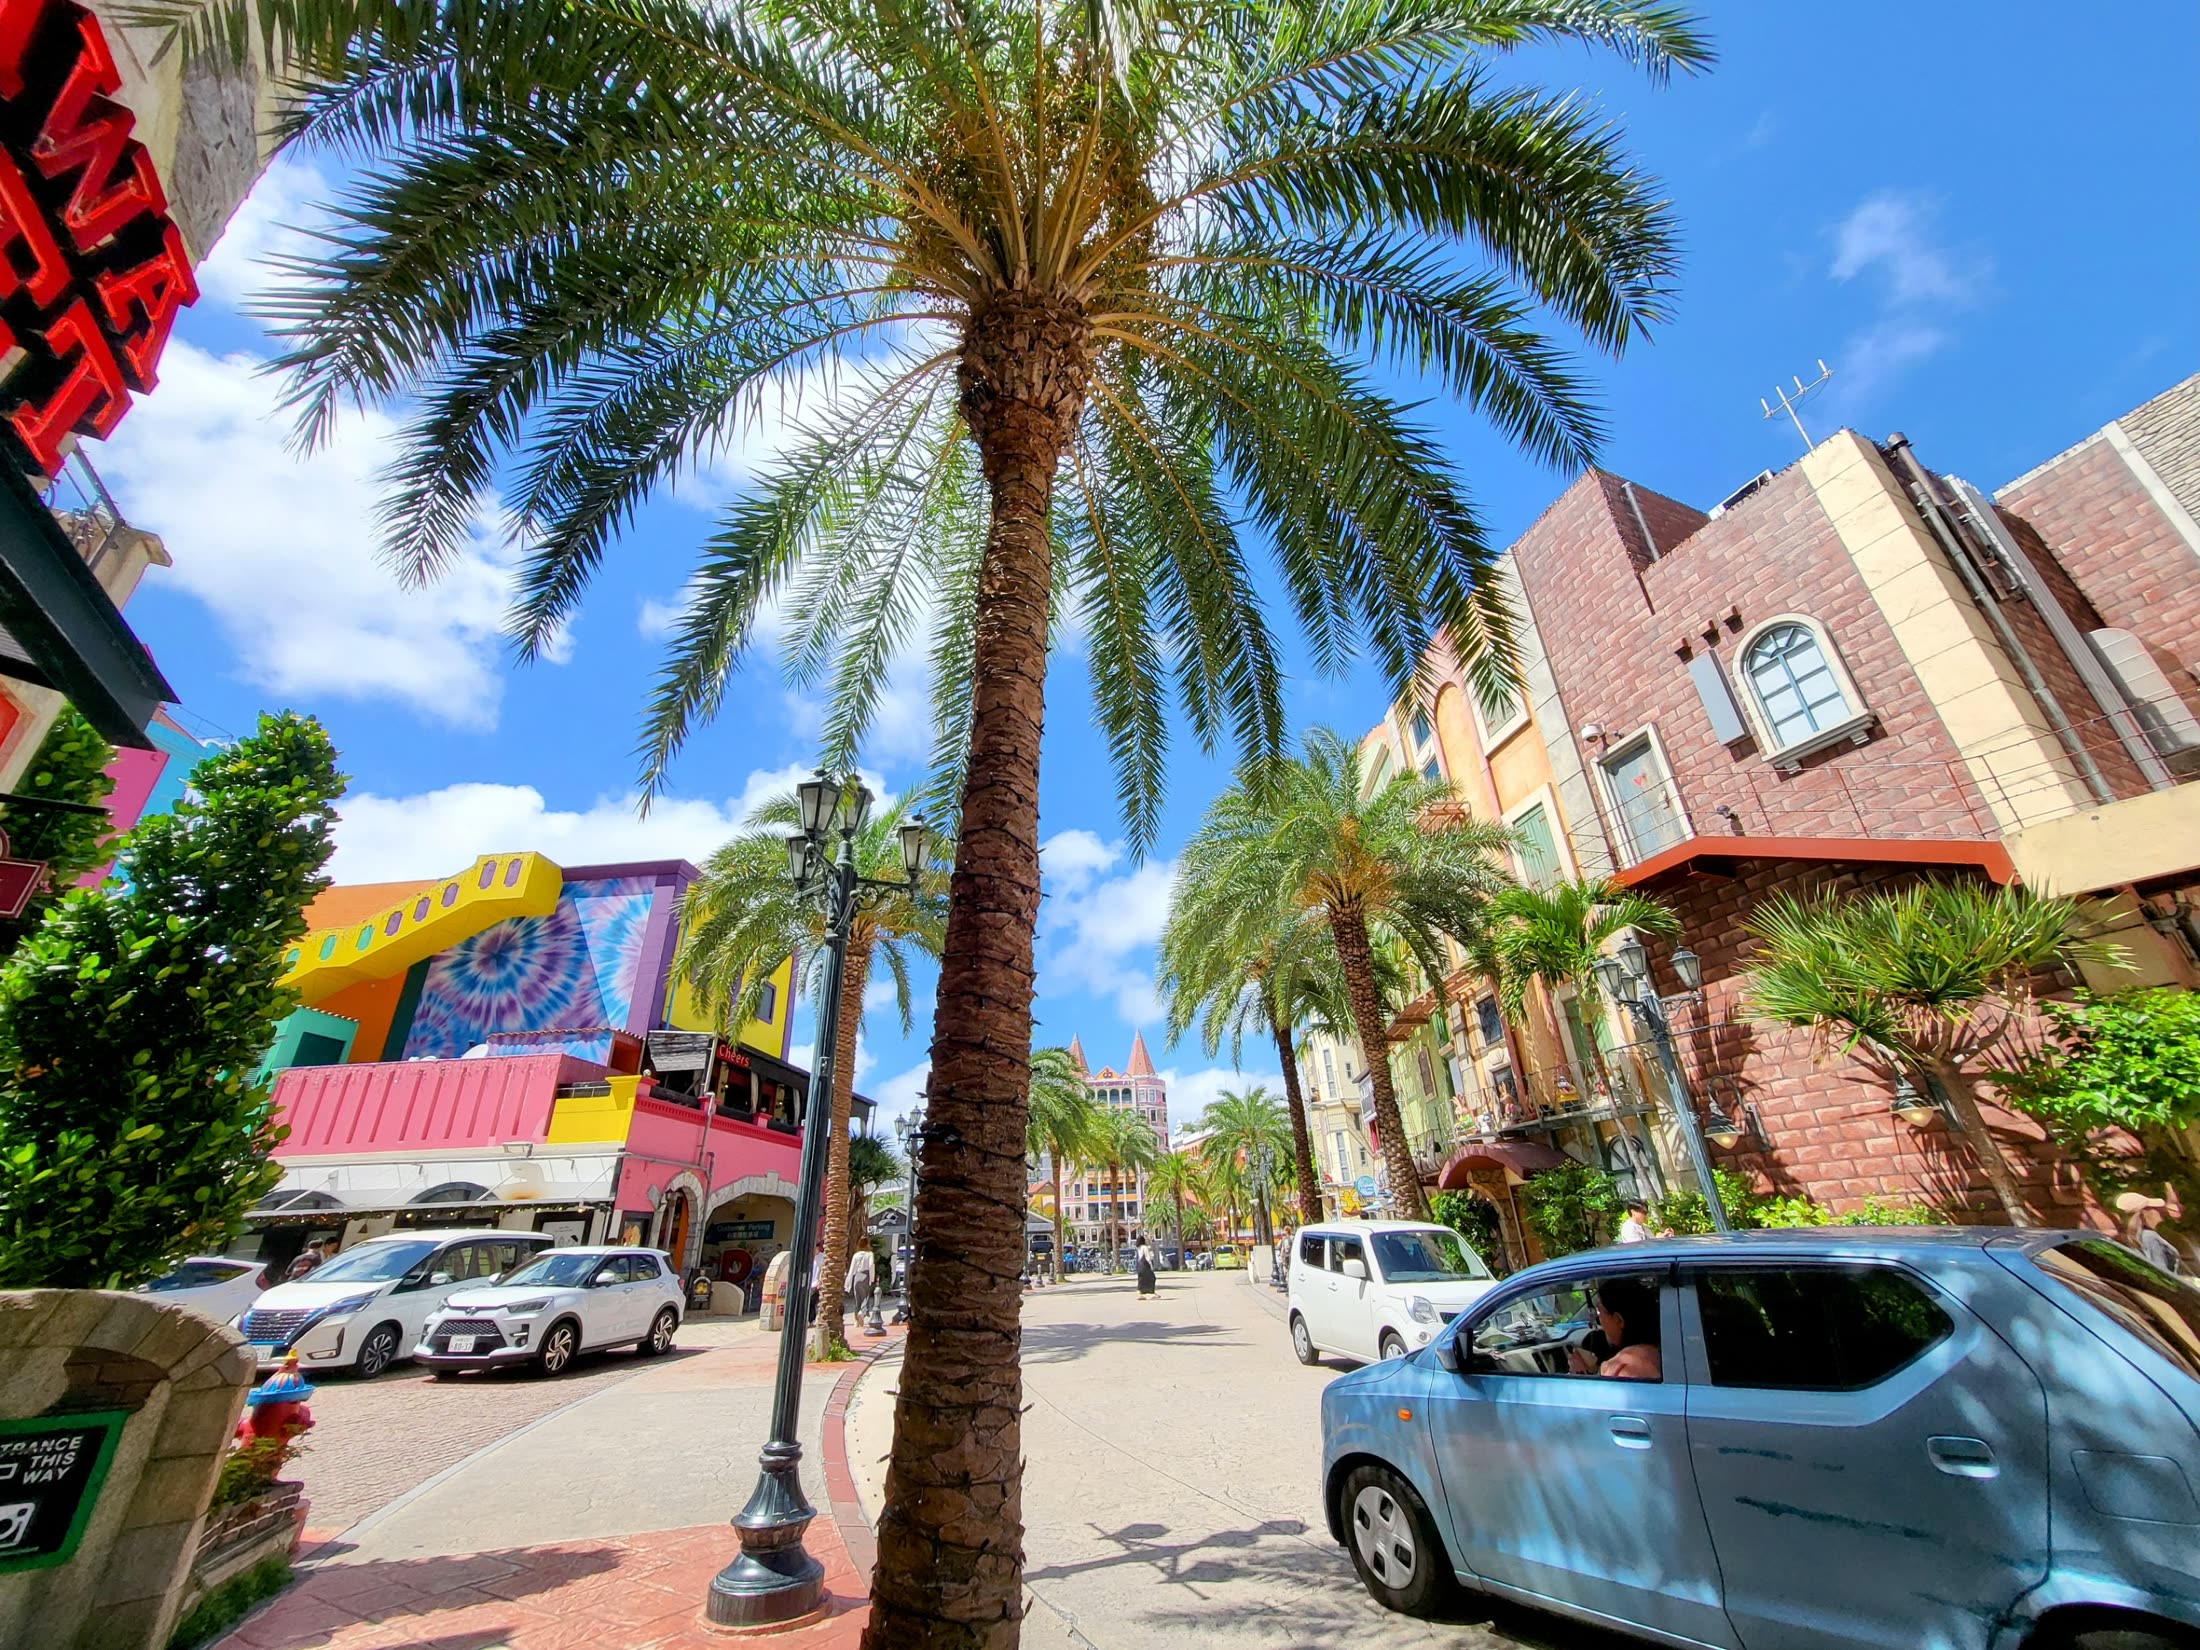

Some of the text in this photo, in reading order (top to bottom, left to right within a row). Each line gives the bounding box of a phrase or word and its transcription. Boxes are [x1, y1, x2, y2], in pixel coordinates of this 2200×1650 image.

[719, 1044, 750, 1067] Cheers
[30, 1451, 77, 1469] THIS
[22, 1466, 71, 1485] WAY
